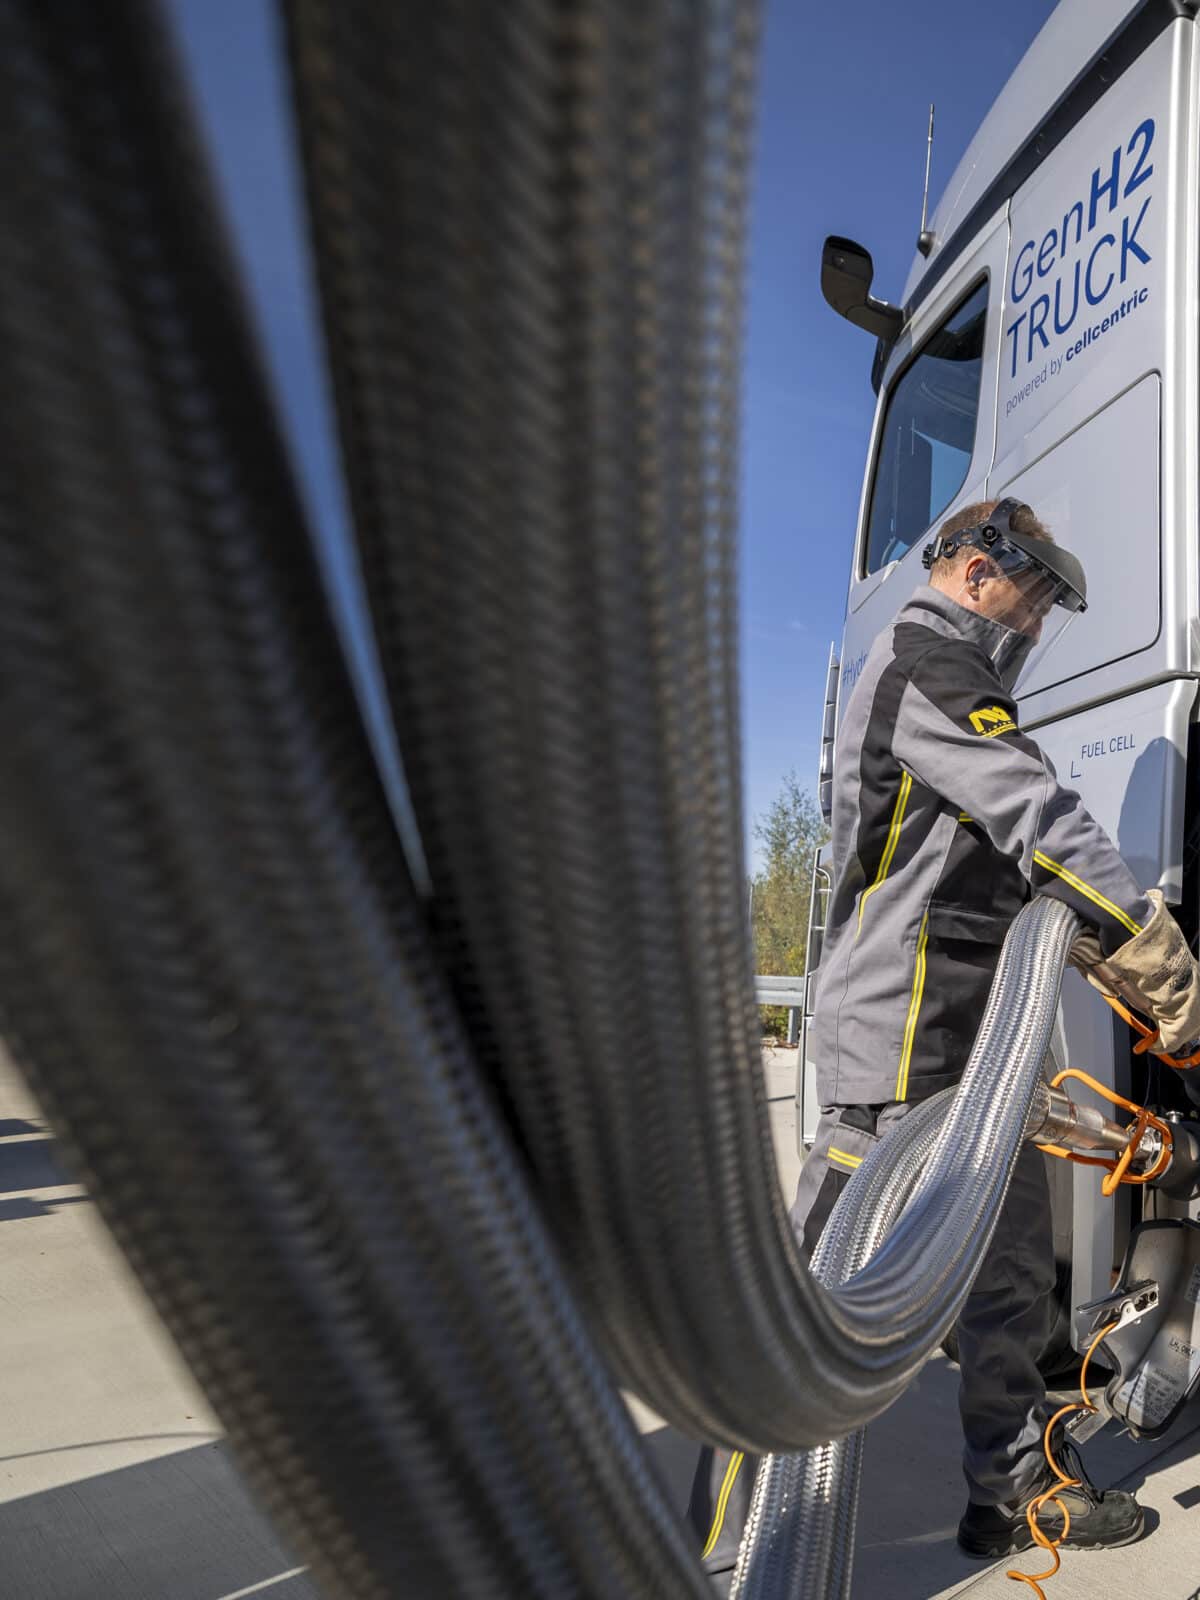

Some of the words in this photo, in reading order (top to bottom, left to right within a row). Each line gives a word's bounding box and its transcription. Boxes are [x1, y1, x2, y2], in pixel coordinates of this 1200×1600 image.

[1006, 195, 1153, 378] TRUCK
[1012, 118, 1156, 304] GenH2
[1006, 362, 1048, 418] powered
[1050, 355, 1064, 376] by
[1065, 287, 1149, 362] cellcentric
[1081, 740, 1107, 760] FUEL
[1109, 733, 1136, 753] CELL
